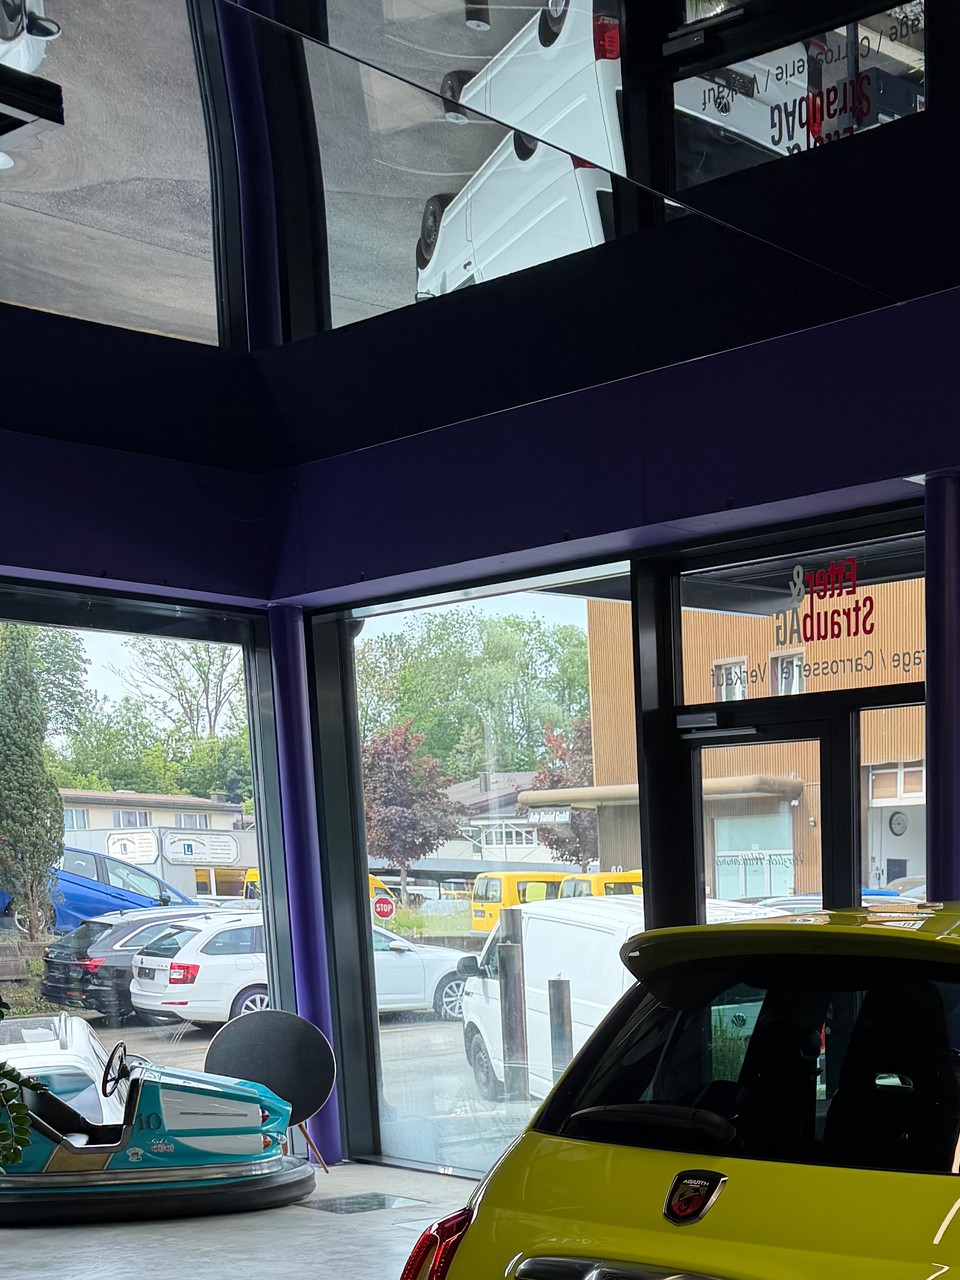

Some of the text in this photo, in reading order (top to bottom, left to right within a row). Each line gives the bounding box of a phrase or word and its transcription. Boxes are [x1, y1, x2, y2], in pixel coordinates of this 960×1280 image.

[375, 903, 392, 912] STOP
[138, 1112, 162, 1130] 10
[682, 1179, 710, 1187] ABARTH
